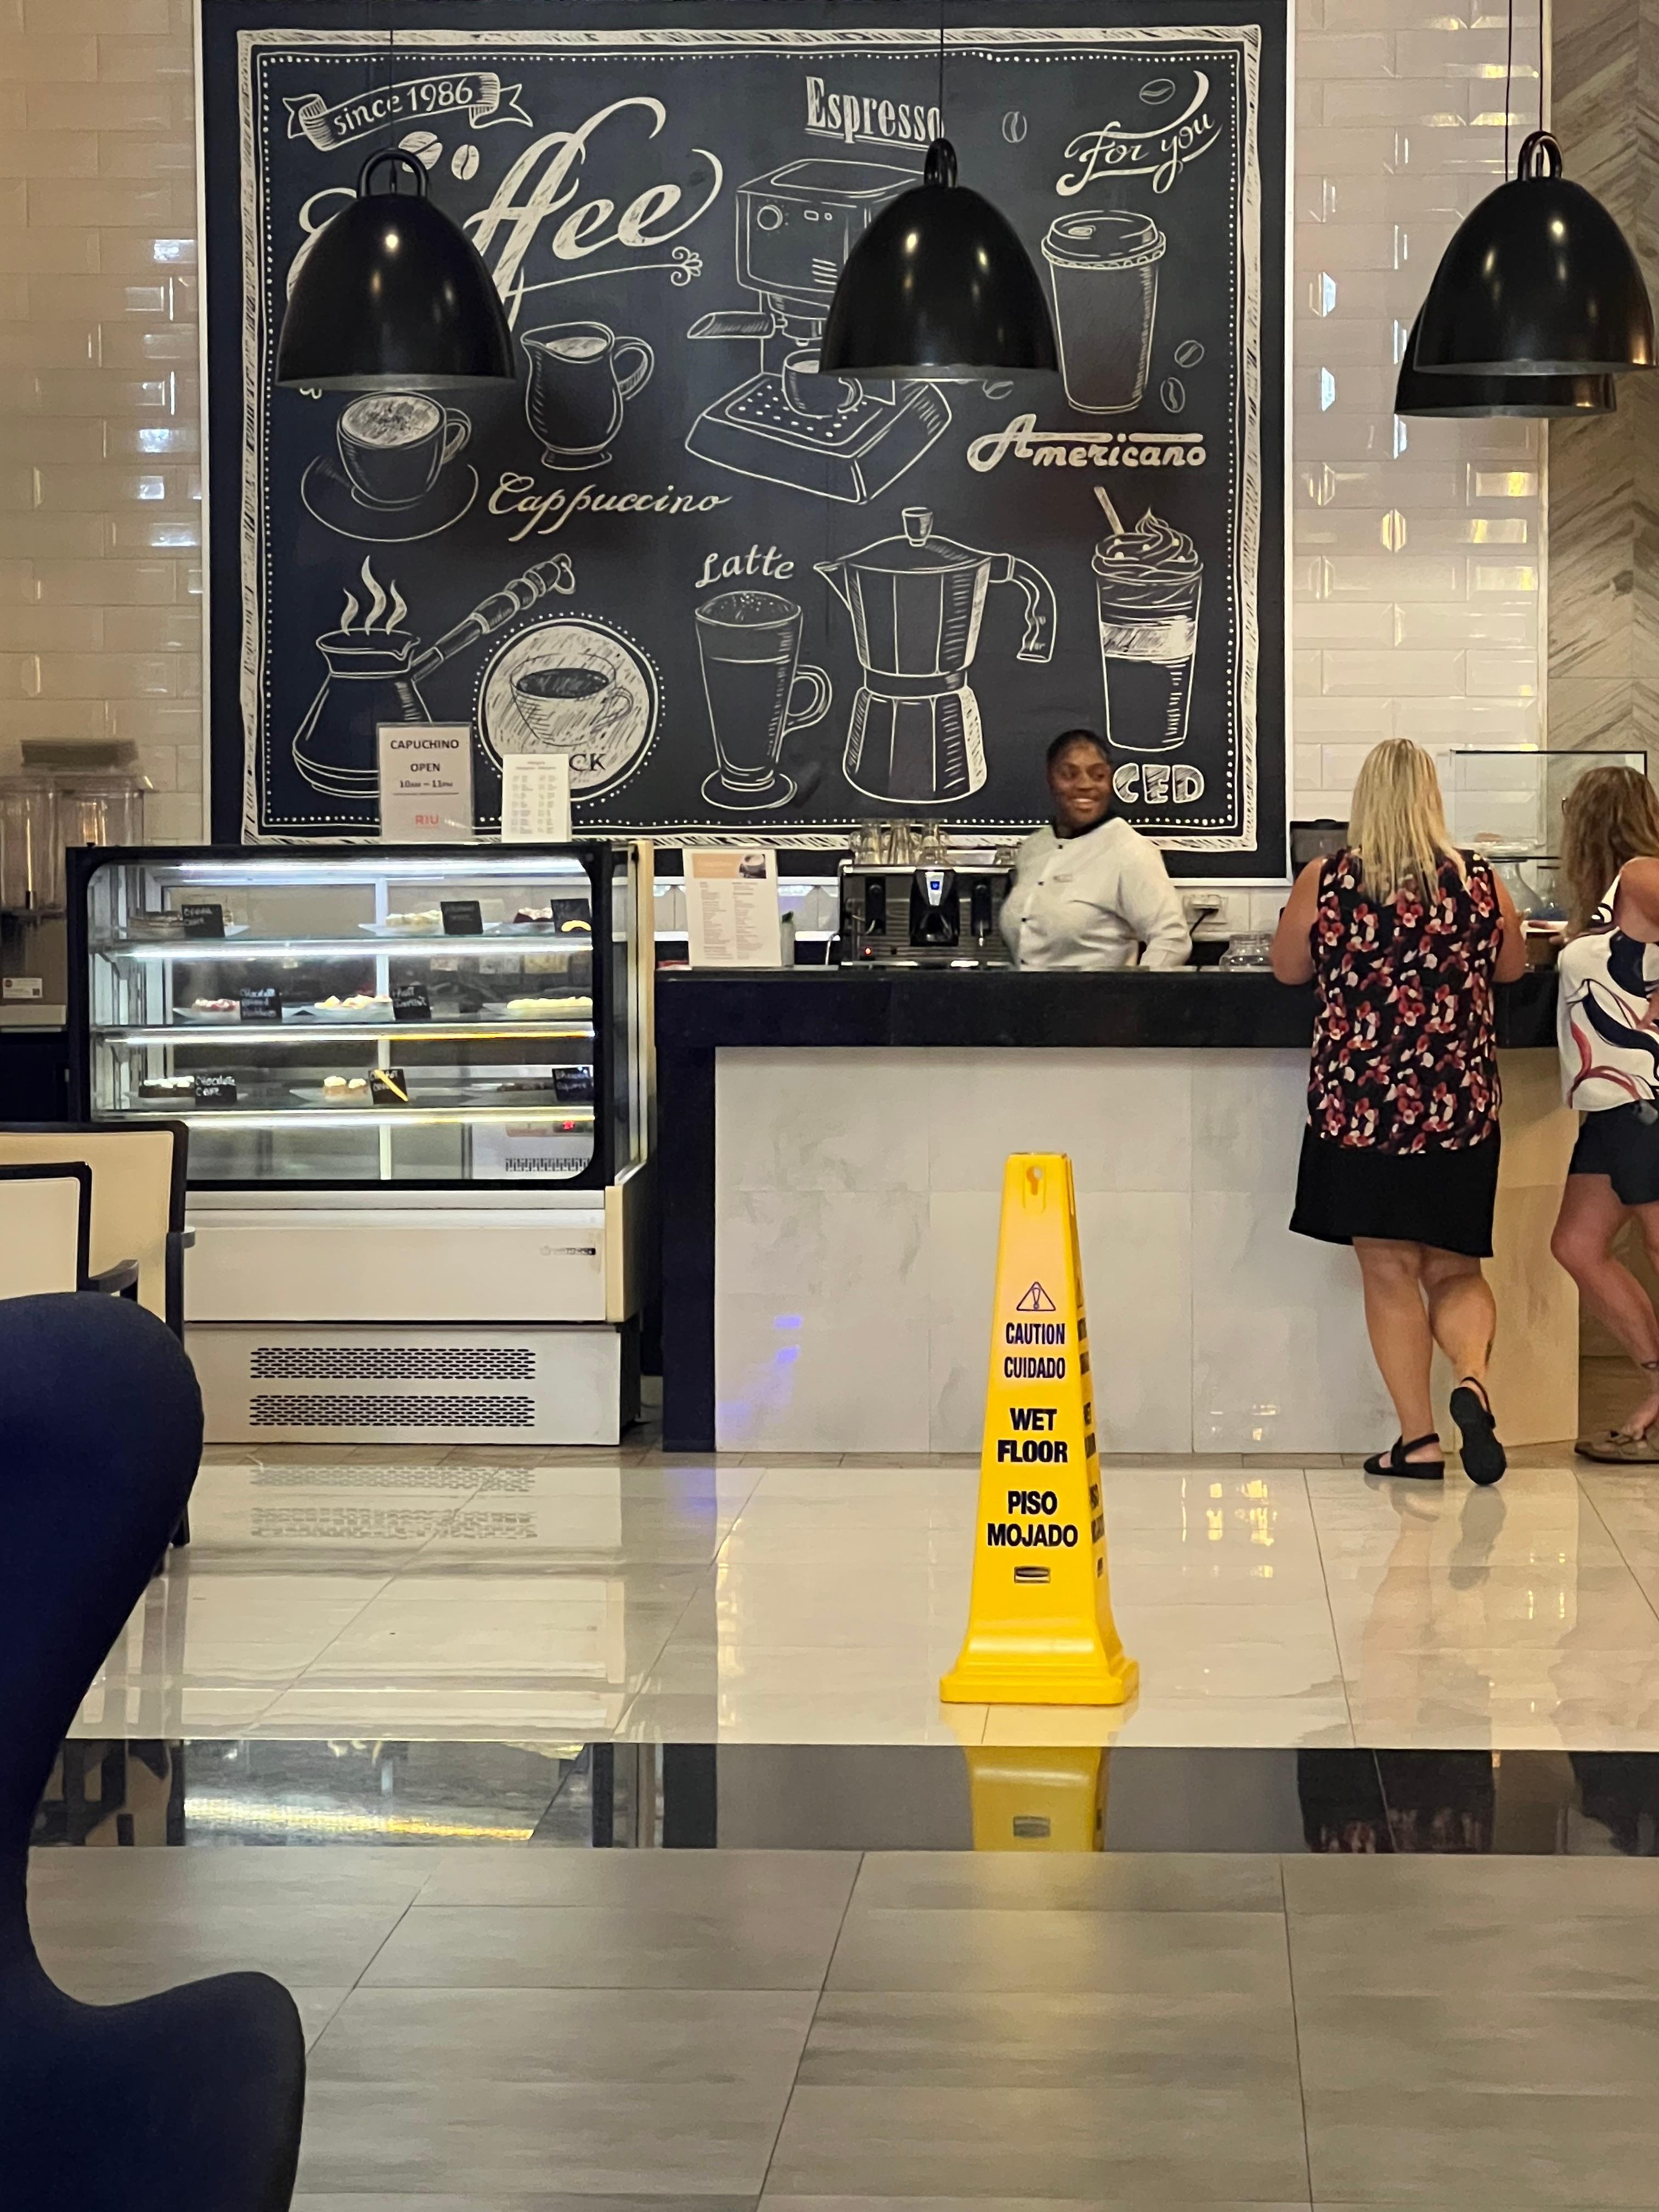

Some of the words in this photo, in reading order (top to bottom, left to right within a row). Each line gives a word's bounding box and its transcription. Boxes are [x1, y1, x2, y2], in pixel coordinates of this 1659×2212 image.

[334, 95, 403, 136] since
[406, 77, 474, 113] 1986
[805, 76, 944, 144] Espresso
[1056, 120, 1149, 196] For
[1152, 109, 1223, 194] you
[967, 413, 1206, 472] Americano
[488, 472, 732, 542] Cappuccino
[695, 544, 794, 588] Latte
[390, 739, 459, 749] CAPUCHINO
[410, 763, 441, 772] OPEN
[1113, 763, 1204, 804] CED
[415, 815, 439, 825] RIU
[1006, 1322, 1066, 1344] CAUTION
[1004, 1356, 1065, 1379] CUIDADO
[1009, 1408, 1057, 1431] WET
[997, 1440, 1068, 1463] FLOOR
[1008, 1491, 1058, 1515] PISO
[988, 1523, 1079, 1547] MOJADO
